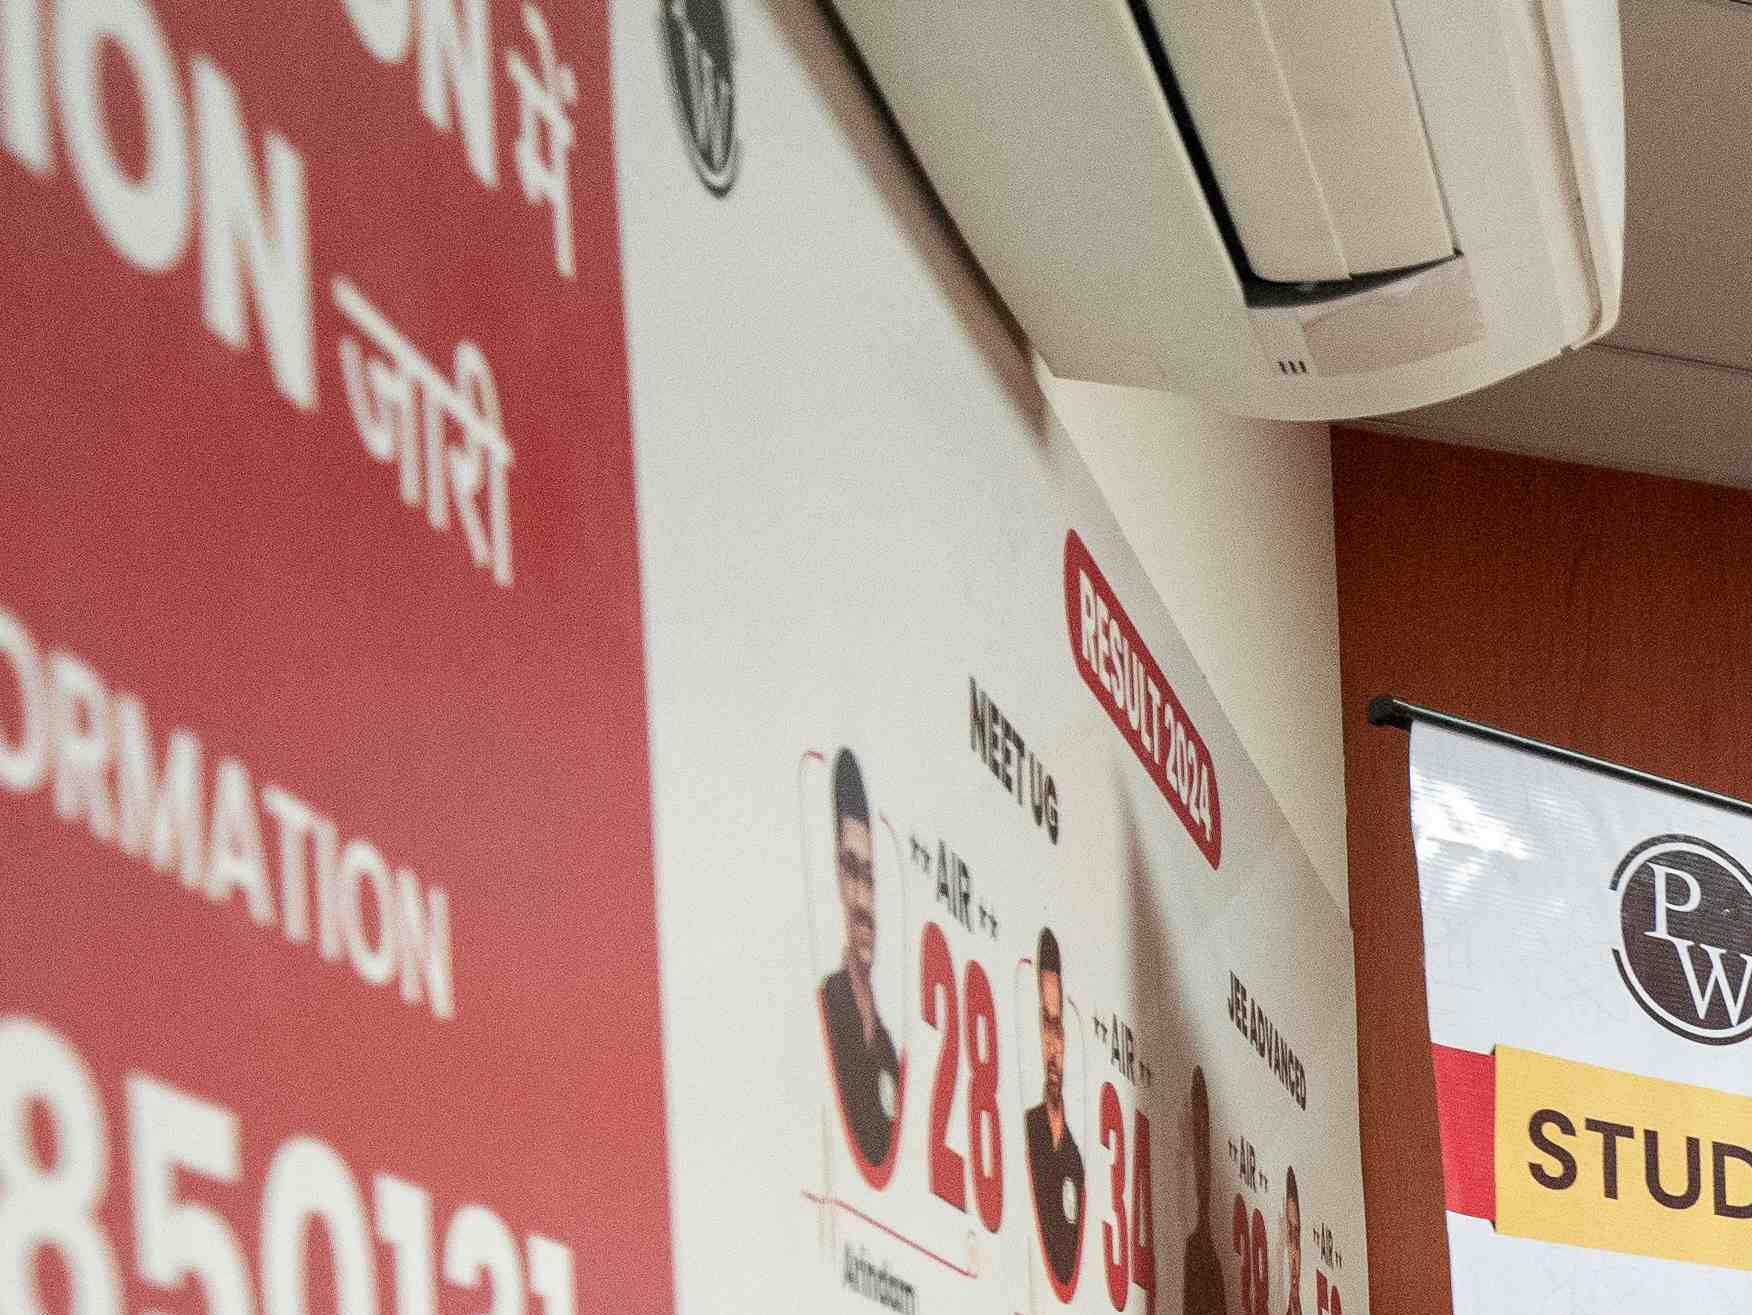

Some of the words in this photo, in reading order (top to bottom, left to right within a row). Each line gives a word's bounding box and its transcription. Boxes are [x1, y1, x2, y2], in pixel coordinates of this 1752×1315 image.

[332, 278, 514, 587] जारी
[968, 676, 1025, 807] NEET
[1028, 759, 1059, 845] UG
[1078, 567, 1162, 768] RESULT
[1164, 717, 1214, 842] 2024
[935, 839, 973, 932] AIR
[919, 921, 1003, 1234] 28
[1110, 1013, 1135, 1086] AIR
[1227, 971, 1249, 1039] JEE
[1249, 996, 1307, 1111] ADVANCED
[1239, 1136, 1257, 1193] AIR
[1320, 1222, 1335, 1270] AIR
